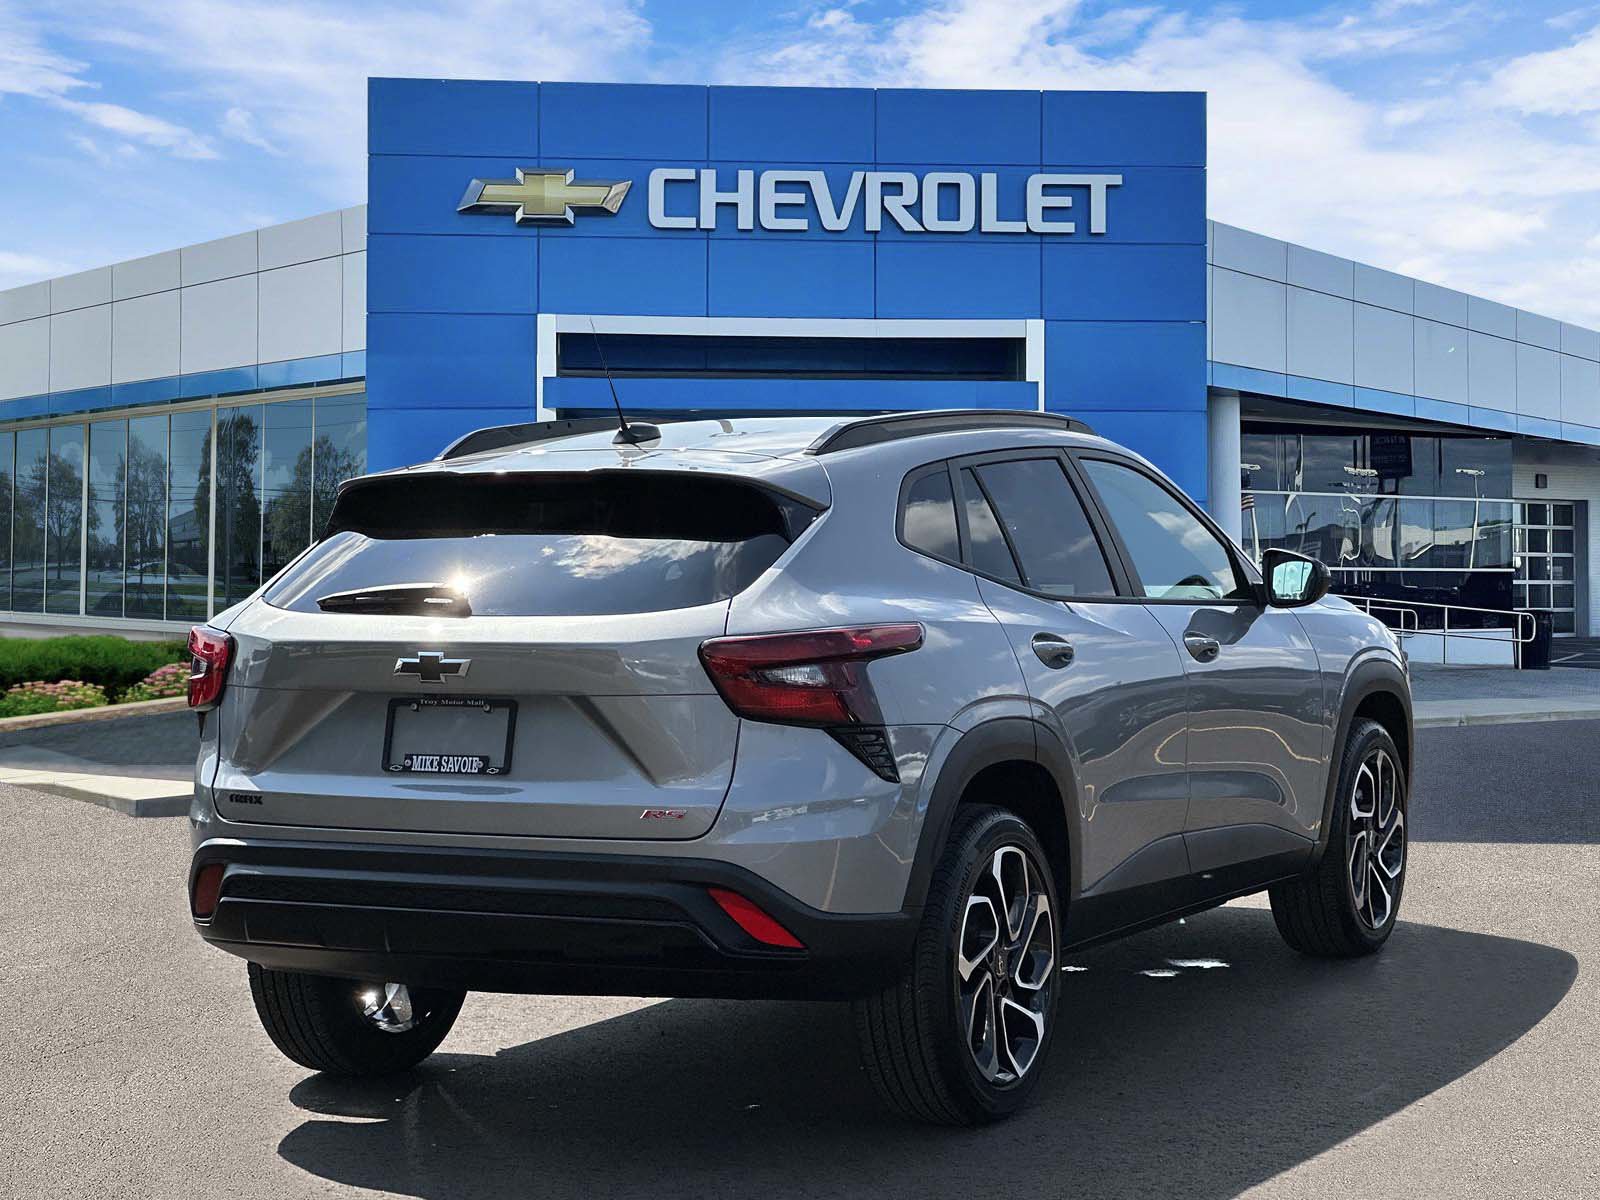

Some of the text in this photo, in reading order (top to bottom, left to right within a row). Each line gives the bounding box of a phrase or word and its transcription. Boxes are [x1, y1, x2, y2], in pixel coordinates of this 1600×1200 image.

[648, 168, 1123, 234] CHEVROLET
[420, 698, 438, 706] Troy
[466, 699, 485, 707] Mall
[411, 755, 480, 774] MIKE SAVOIE
[639, 808, 688, 820] RS
